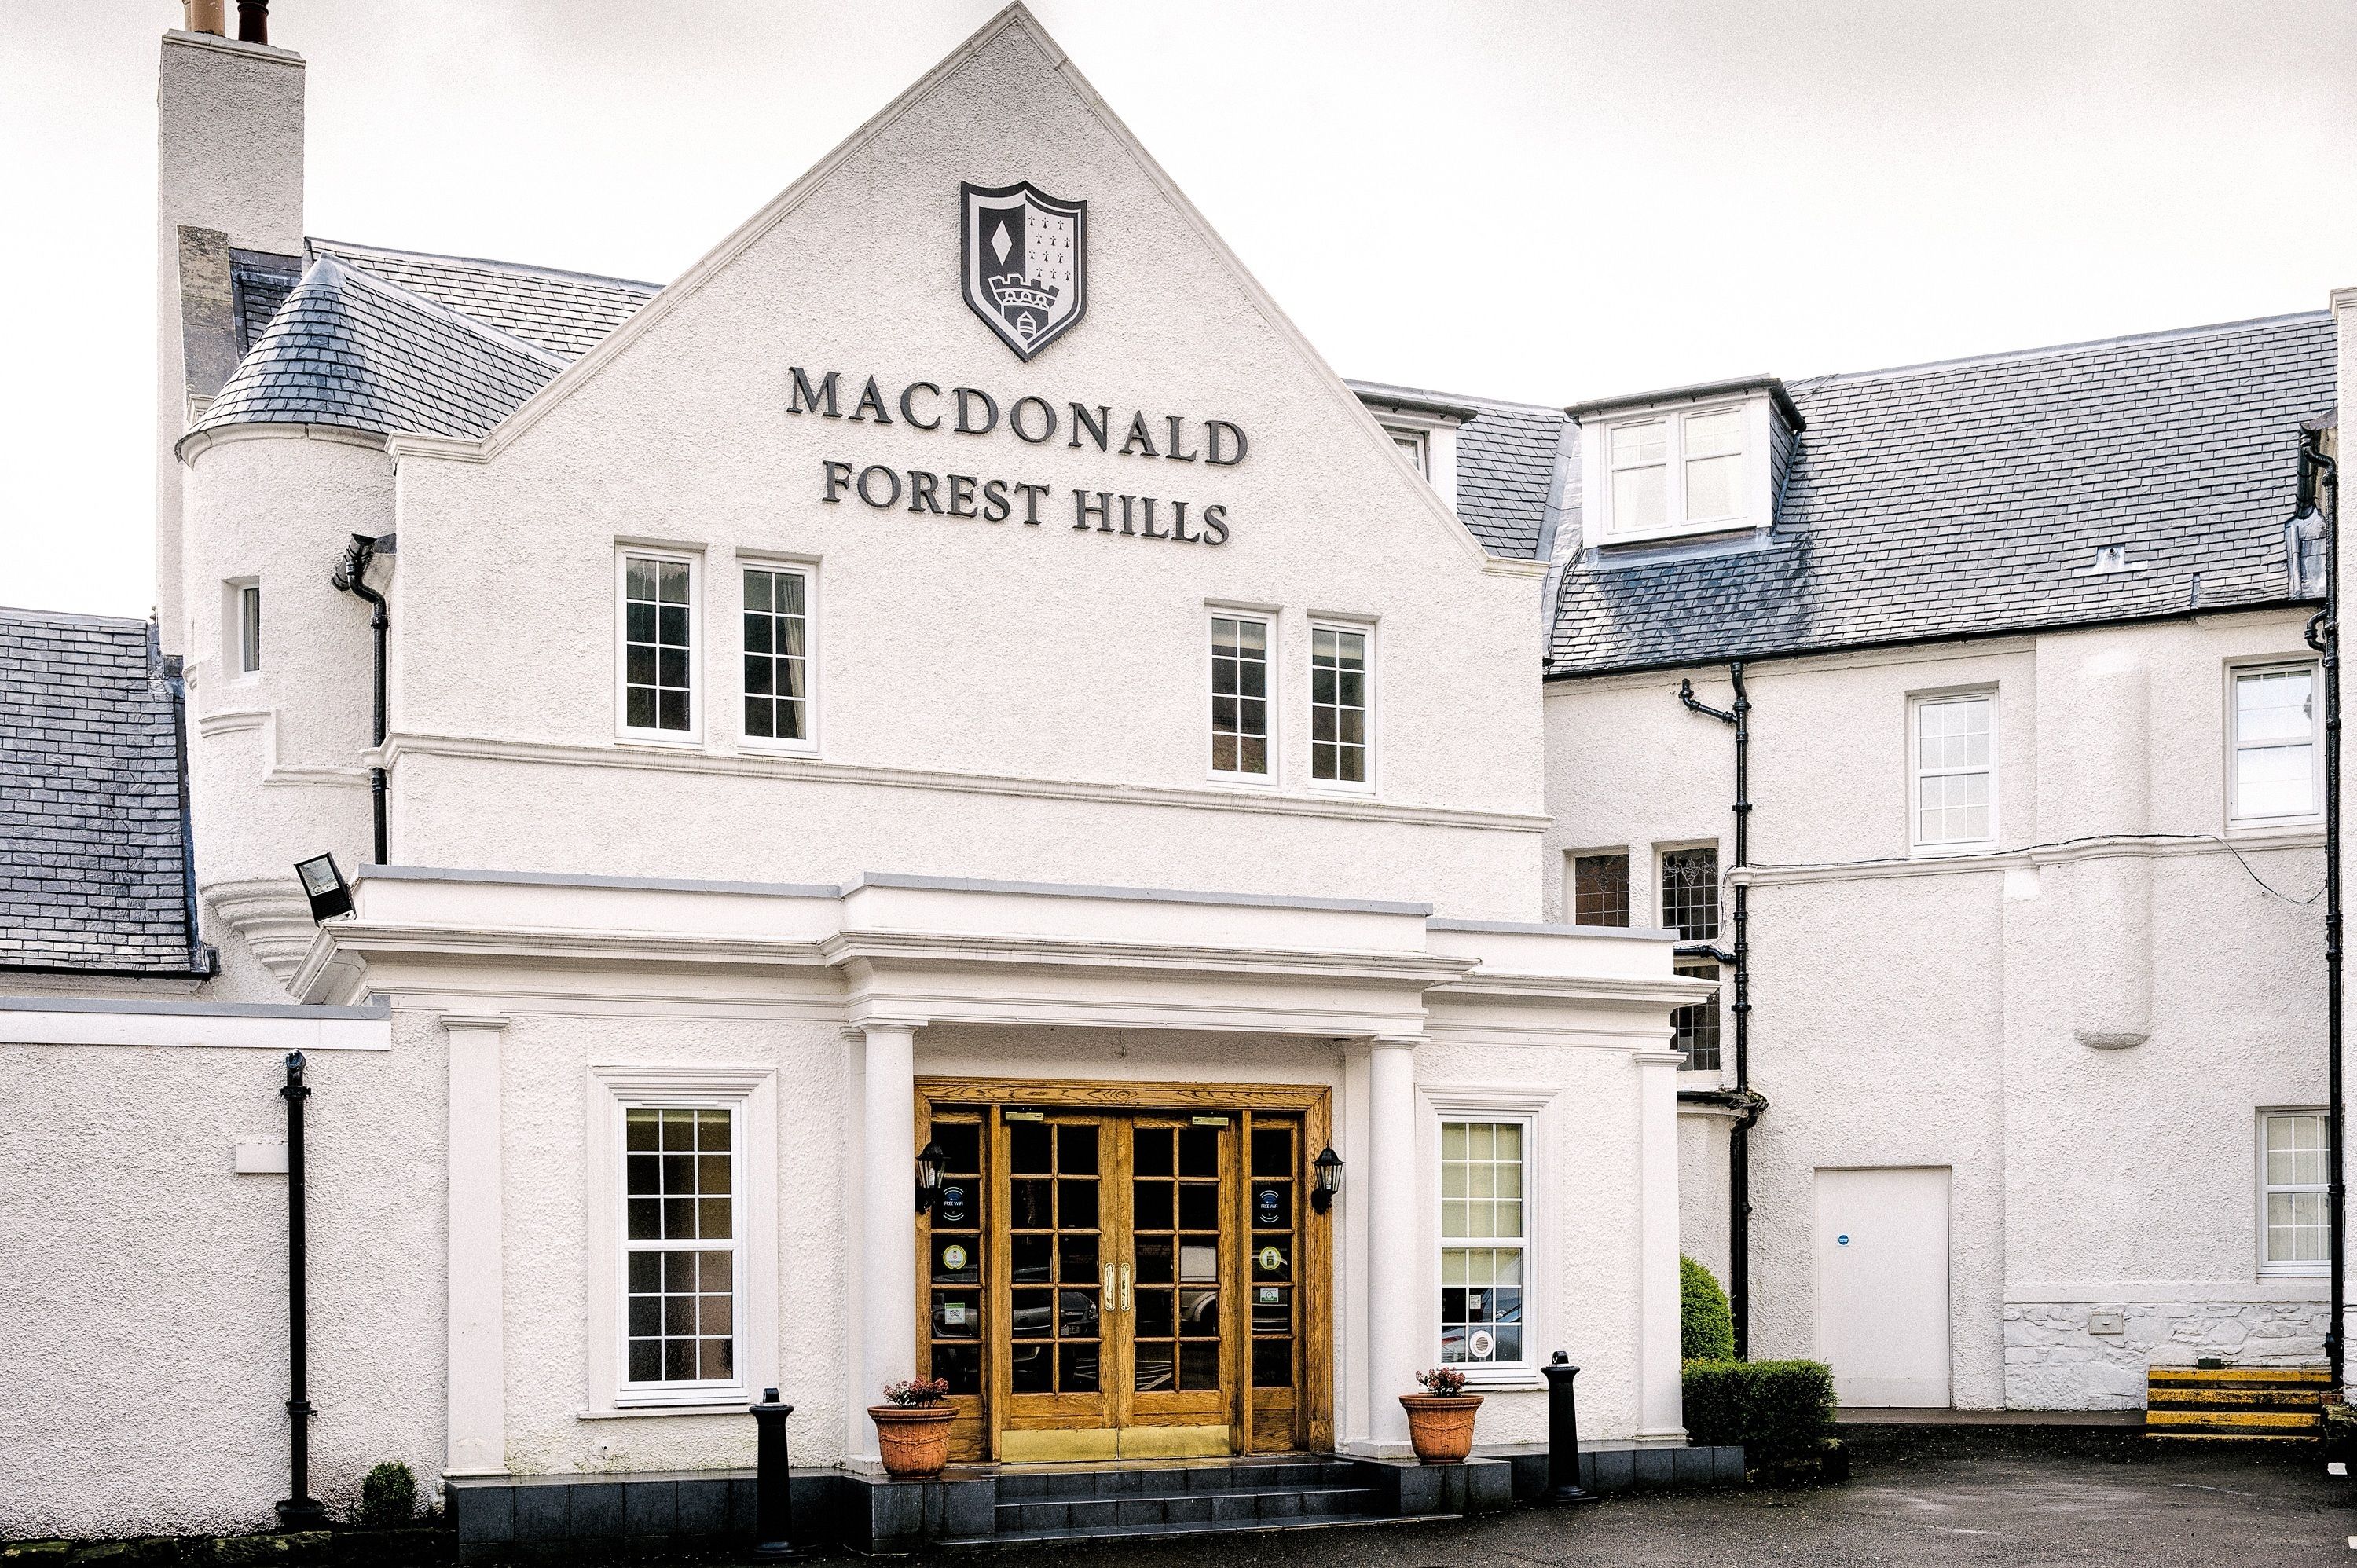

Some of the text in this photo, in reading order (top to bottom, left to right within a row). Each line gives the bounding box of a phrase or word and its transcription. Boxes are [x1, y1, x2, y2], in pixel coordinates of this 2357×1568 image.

[786, 366, 1248, 466] MACDONALD
[822, 460, 1230, 547] FOREST HILLS
